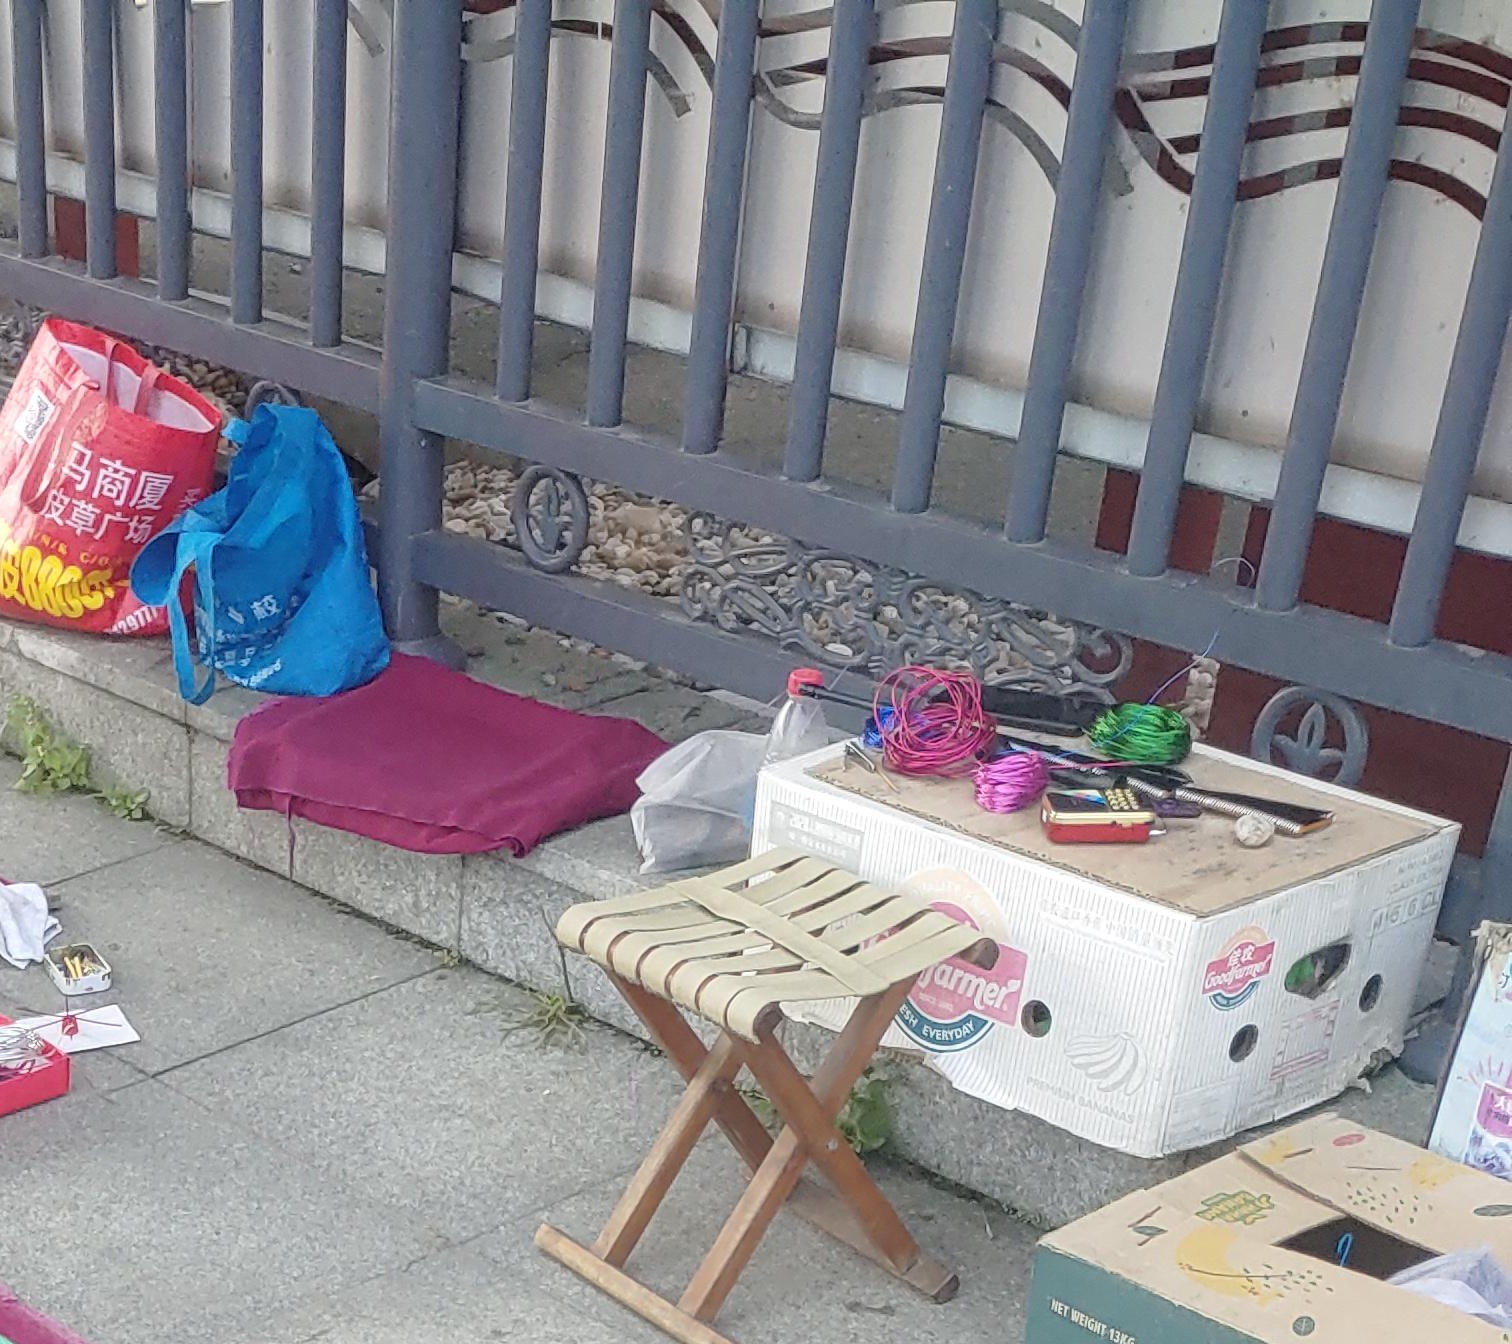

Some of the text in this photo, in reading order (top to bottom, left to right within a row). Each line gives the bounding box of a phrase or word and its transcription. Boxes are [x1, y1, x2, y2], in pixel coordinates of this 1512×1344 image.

[41, 487, 157, 544] 皮草广场
[922, 1020, 975, 1042] EVERYDAY
[1081, 1097, 1135, 1124] BANANAS
[1050, 1298, 1069, 1318] NET
[1070, 1307, 1108, 1337] WEIGHT
